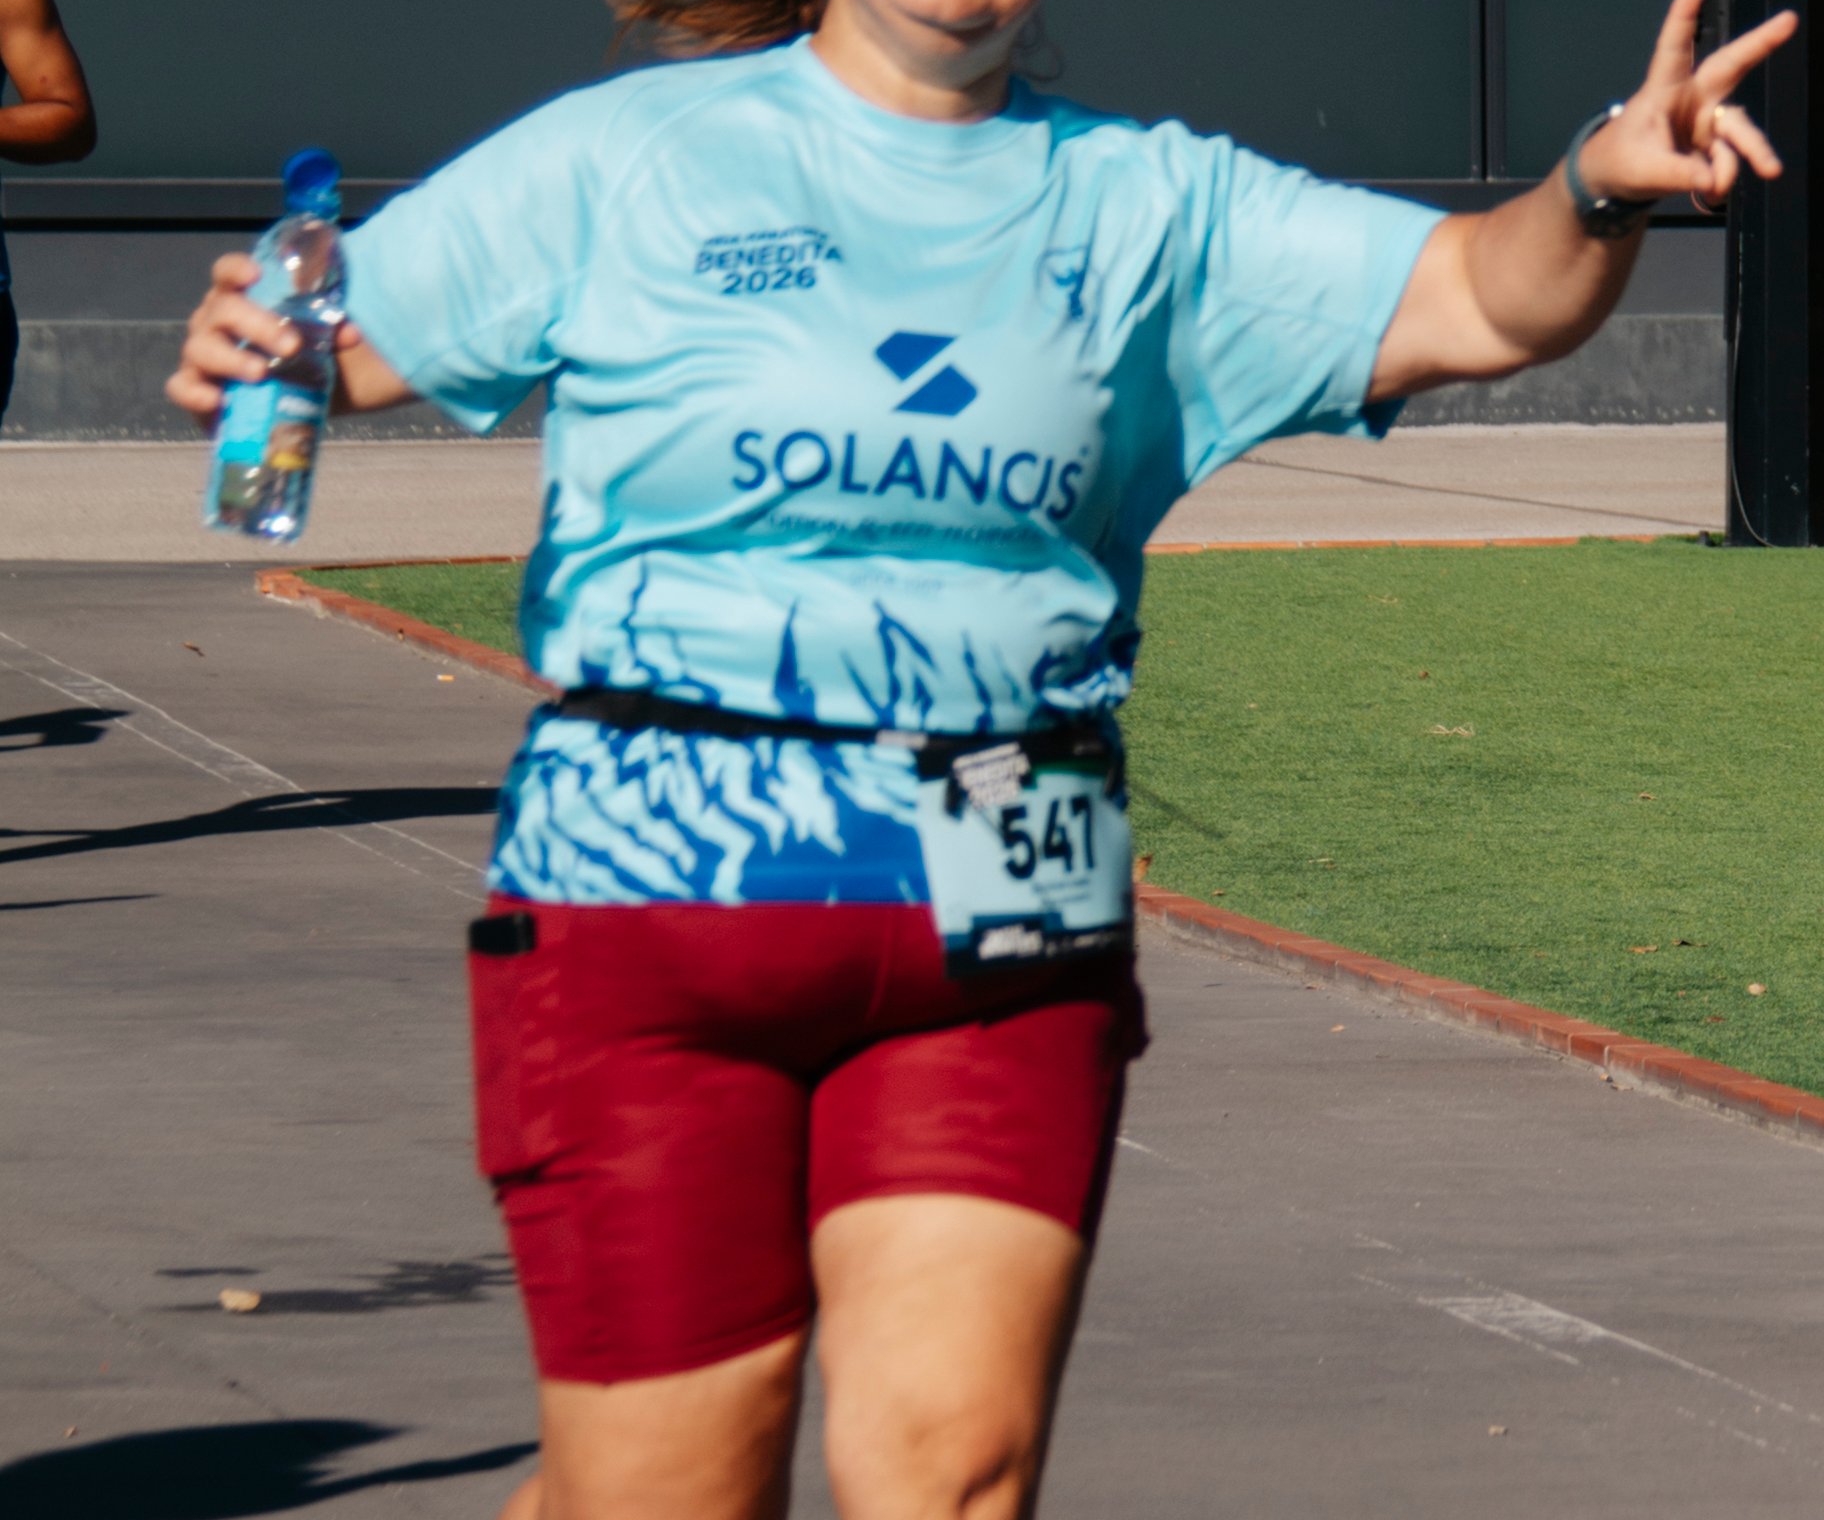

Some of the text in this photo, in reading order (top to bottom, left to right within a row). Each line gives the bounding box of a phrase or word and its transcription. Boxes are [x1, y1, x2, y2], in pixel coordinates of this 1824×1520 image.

[693, 239, 844, 275] BENEDITA
[720, 265, 817, 296] 2026
[732, 429, 1083, 522] SOLANCIS
